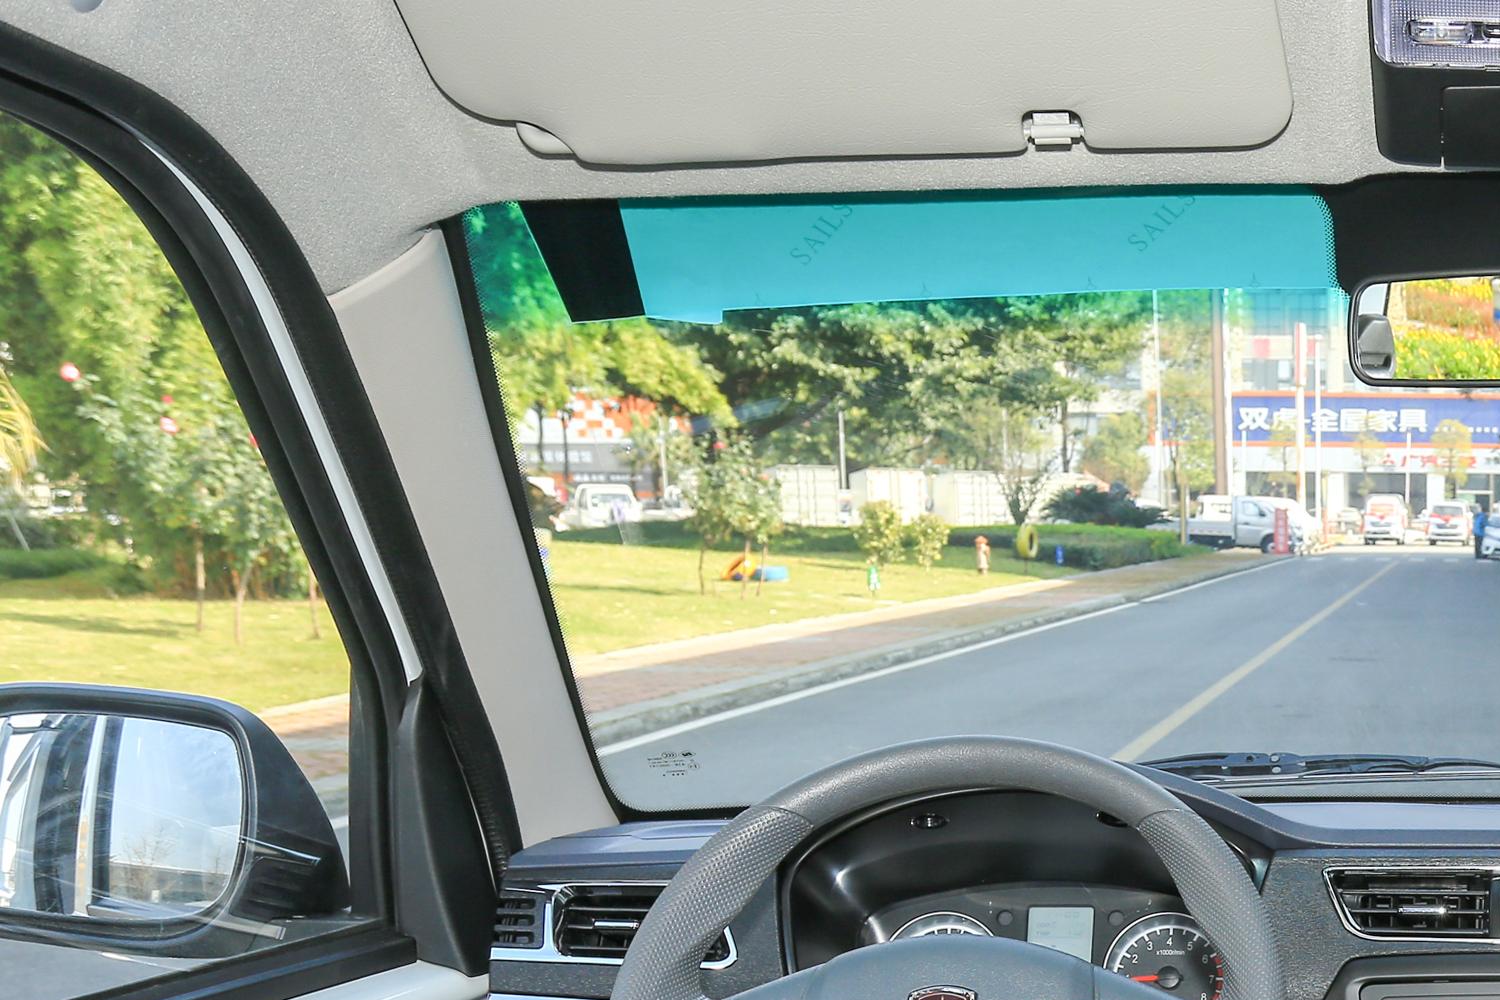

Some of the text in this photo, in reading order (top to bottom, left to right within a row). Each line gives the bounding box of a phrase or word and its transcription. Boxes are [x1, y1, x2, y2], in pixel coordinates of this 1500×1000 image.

[1127, 195, 1196, 252] SAILS
[789, 204, 853, 265] SAILS
[1146, 941, 1153, 951] 3
[1166, 937, 1173, 947] 4
[1186, 941, 1193, 951] 5
[1131, 954, 1138, 964] 2
[1201, 954, 1208, 964] 6
[1209, 974, 1215, 984] 7
